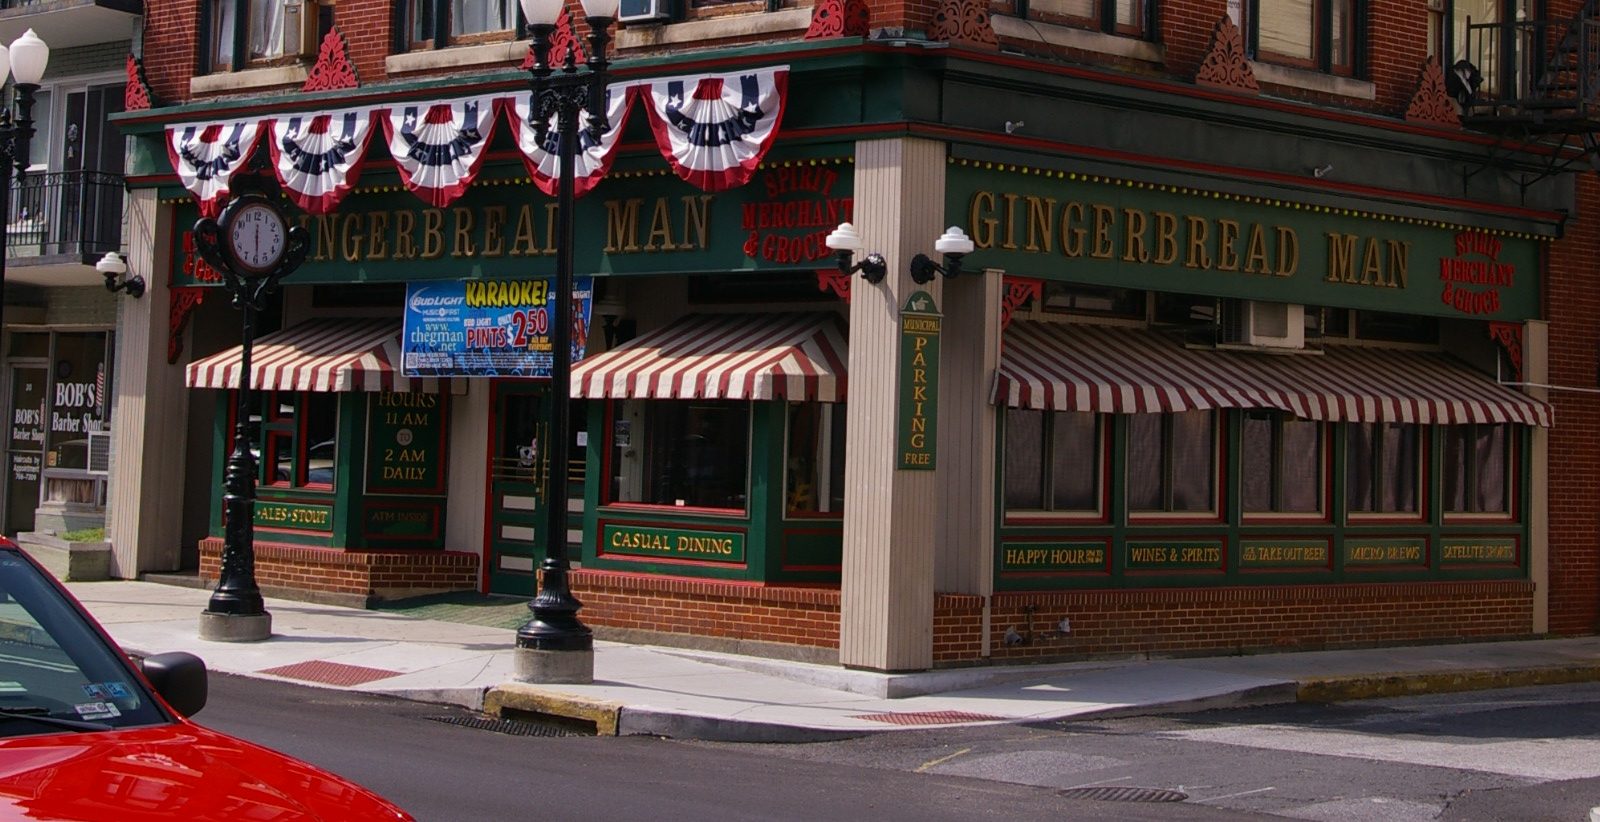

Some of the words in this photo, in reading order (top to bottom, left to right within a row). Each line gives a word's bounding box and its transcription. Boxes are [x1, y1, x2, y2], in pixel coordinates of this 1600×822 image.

[741, 197, 854, 230] MERCHANT
[290, 201, 559, 262] NGERBREA
[603, 193, 716, 253] MAN
[969, 189, 1299, 277] GINGERBREAD
[1325, 232, 1412, 288] MAN
[1439, 256, 1516, 288] MERCHANT
[413, 296, 434, 306] BUD
[434, 296, 465, 306] LIGHT
[466, 280, 549, 308] KARAOKE!
[425, 323, 450, 332] www.
[904, 318, 941, 331] MUNICIPAL
[411, 326, 465, 347] thegman
[466, 326, 507, 349] PINTS
[438, 342, 457, 352] .net
[55, 382, 96, 407] BOB'S
[377, 391, 436, 408] HOURS
[911, 337, 928, 449] PARKING
[15, 408, 39, 424] BOB'S
[52, 412, 80, 432] Barber
[386, 412, 398, 425] 11
[402, 413, 428, 426] AM
[13, 427, 31, 440] Barber
[384, 449, 394, 462] 2
[399, 450, 425, 462] AM
[905, 453, 930, 464] FREE
[383, 466, 427, 480] DAILY
[260, 507, 287, 521] ALES
[291, 509, 328, 524] STOUT
[611, 531, 671, 551] CASUAL
[677, 536, 733, 555] DINING
[1006, 549, 1048, 565] HAPPY
[1050, 549, 1086, 564] HOUR
[1131, 547, 1167, 562] WINES
[1169, 548, 1178, 562] &
[1181, 547, 1220, 562] SPIRITS
[1258, 546, 1282, 561] TAKE
[1283, 547, 1303, 561] OUT
